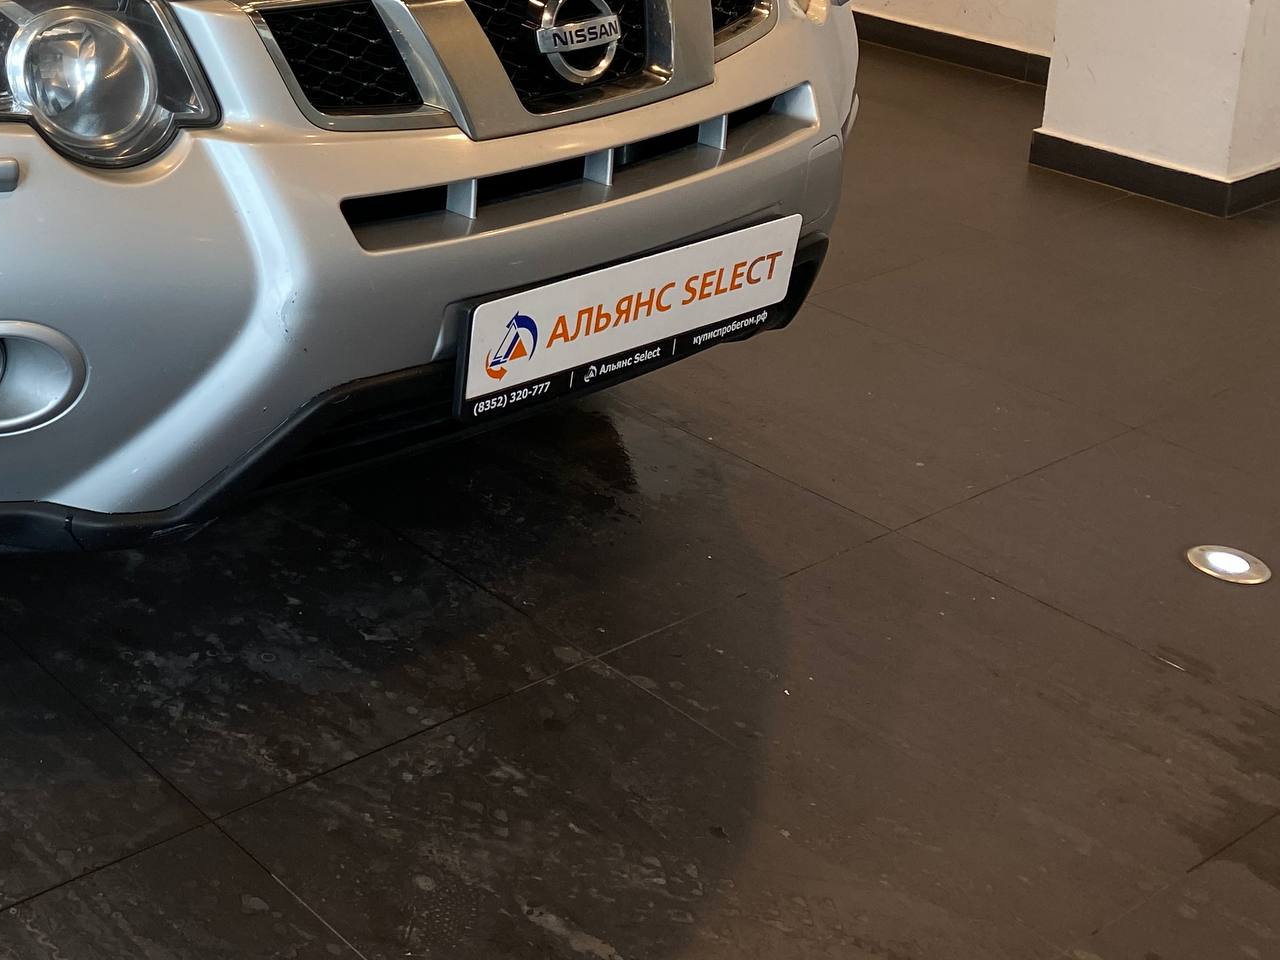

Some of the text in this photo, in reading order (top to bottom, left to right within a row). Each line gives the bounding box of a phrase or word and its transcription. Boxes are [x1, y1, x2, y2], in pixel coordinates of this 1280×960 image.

[552, 20, 619, 47] NISSAN
[545, 250, 783, 349] АЛЬЯНС SELECT
[473, 310, 768, 417] (8352) 320-777 Альянс Select куписпробегом.рф
